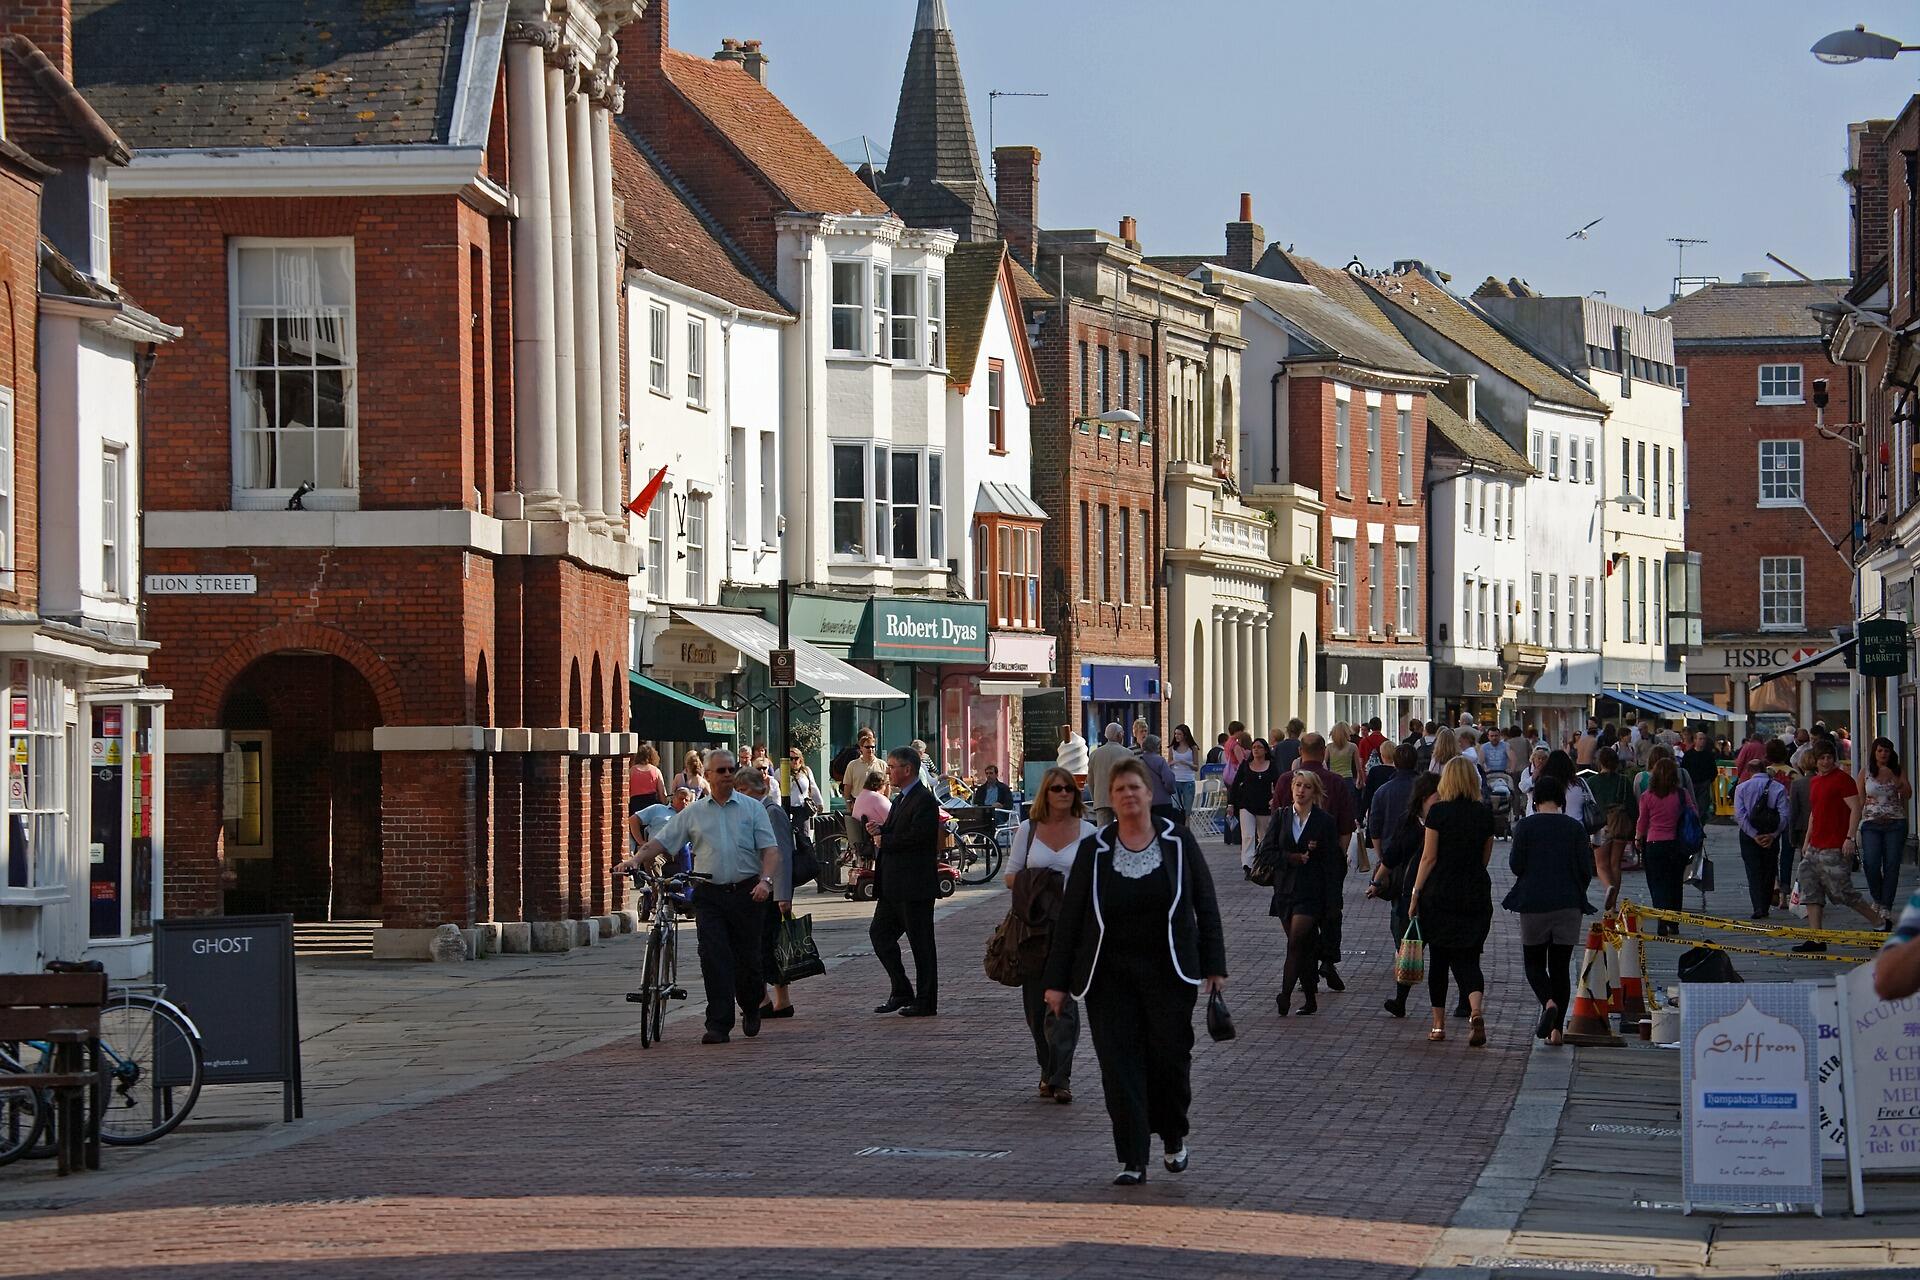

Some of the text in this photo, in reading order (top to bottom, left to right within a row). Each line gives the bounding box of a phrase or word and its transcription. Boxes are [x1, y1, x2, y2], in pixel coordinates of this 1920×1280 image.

[152, 579, 250, 590] LION STREET
[886, 614, 977, 644] Robert Dyas
[1723, 648, 1788, 667] HSBC
[1865, 653, 1901, 663] BARRETT
[192, 937, 253, 953] GHOST
[1703, 1032, 1796, 1063] Saffron
[1874, 1047, 1888, 1062] &
[1760, 1094, 1794, 1104] Bazaar
[1878, 1107, 1904, 1117] Free
[1869, 1124, 1892, 1137] 2A
[1866, 1141, 1893, 1153] Tel:
